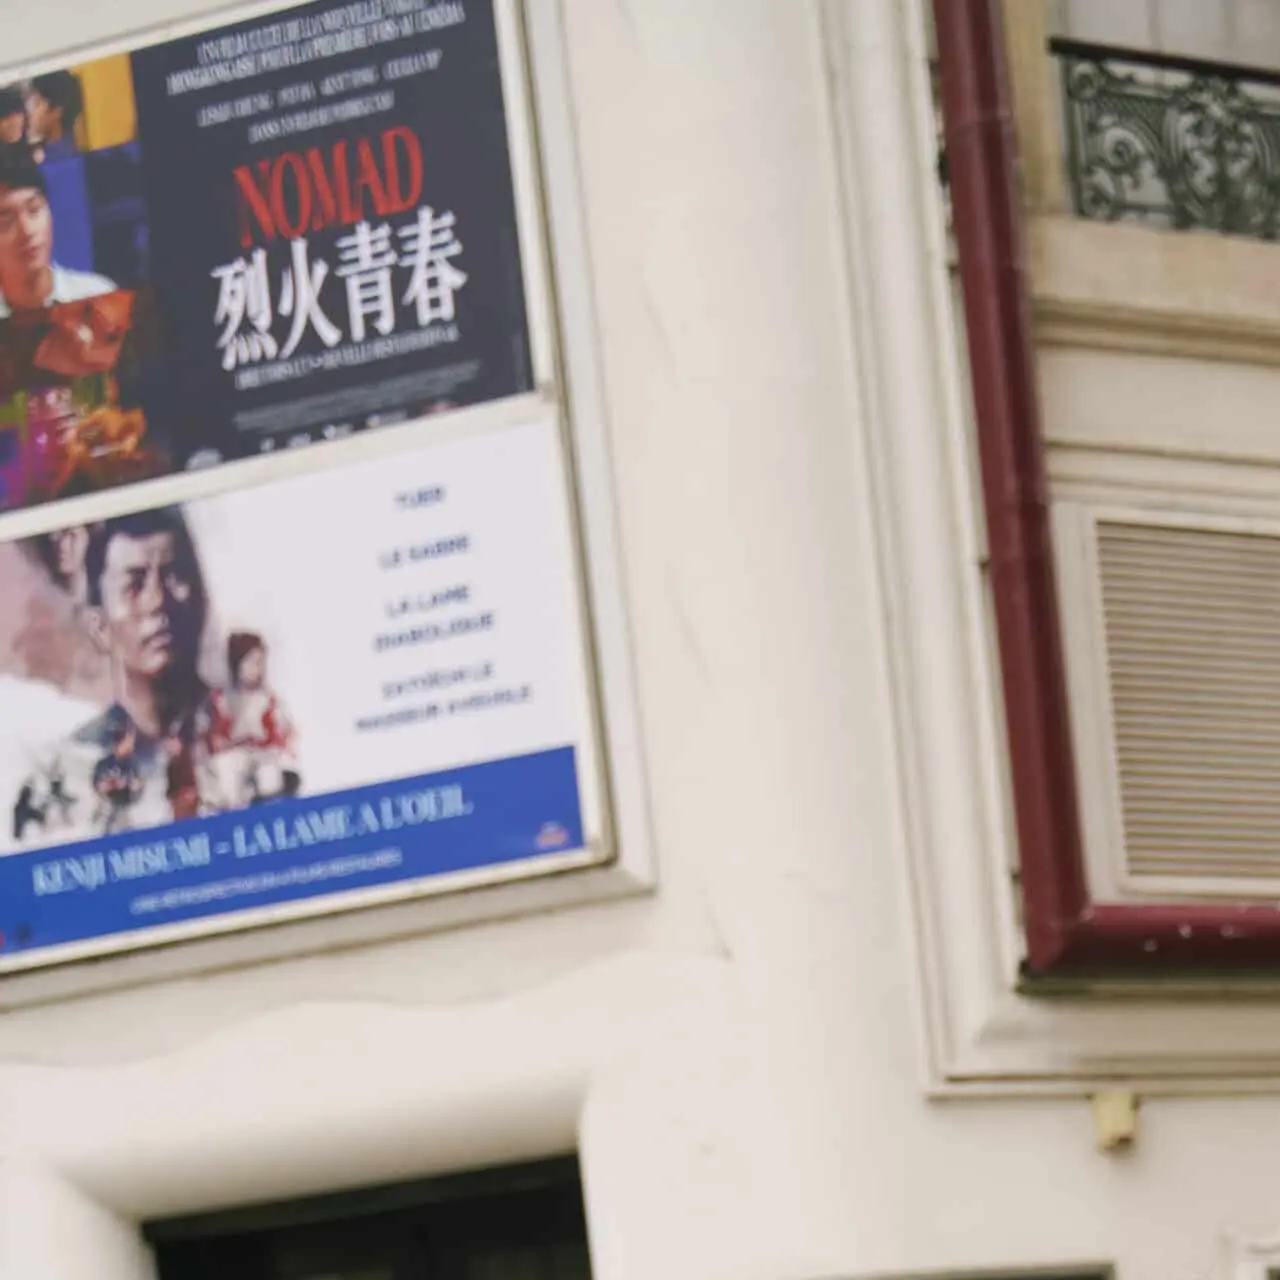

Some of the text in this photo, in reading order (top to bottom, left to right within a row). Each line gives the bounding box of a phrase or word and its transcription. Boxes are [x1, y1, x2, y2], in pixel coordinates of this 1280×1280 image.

[233, 125, 424, 248] NOMAD
[209, 204, 468, 371] 烈火青春
[32, 851, 107, 897] KENJI
[232, 824, 273, 858] LA
[273, 804, 354, 850] LAME
